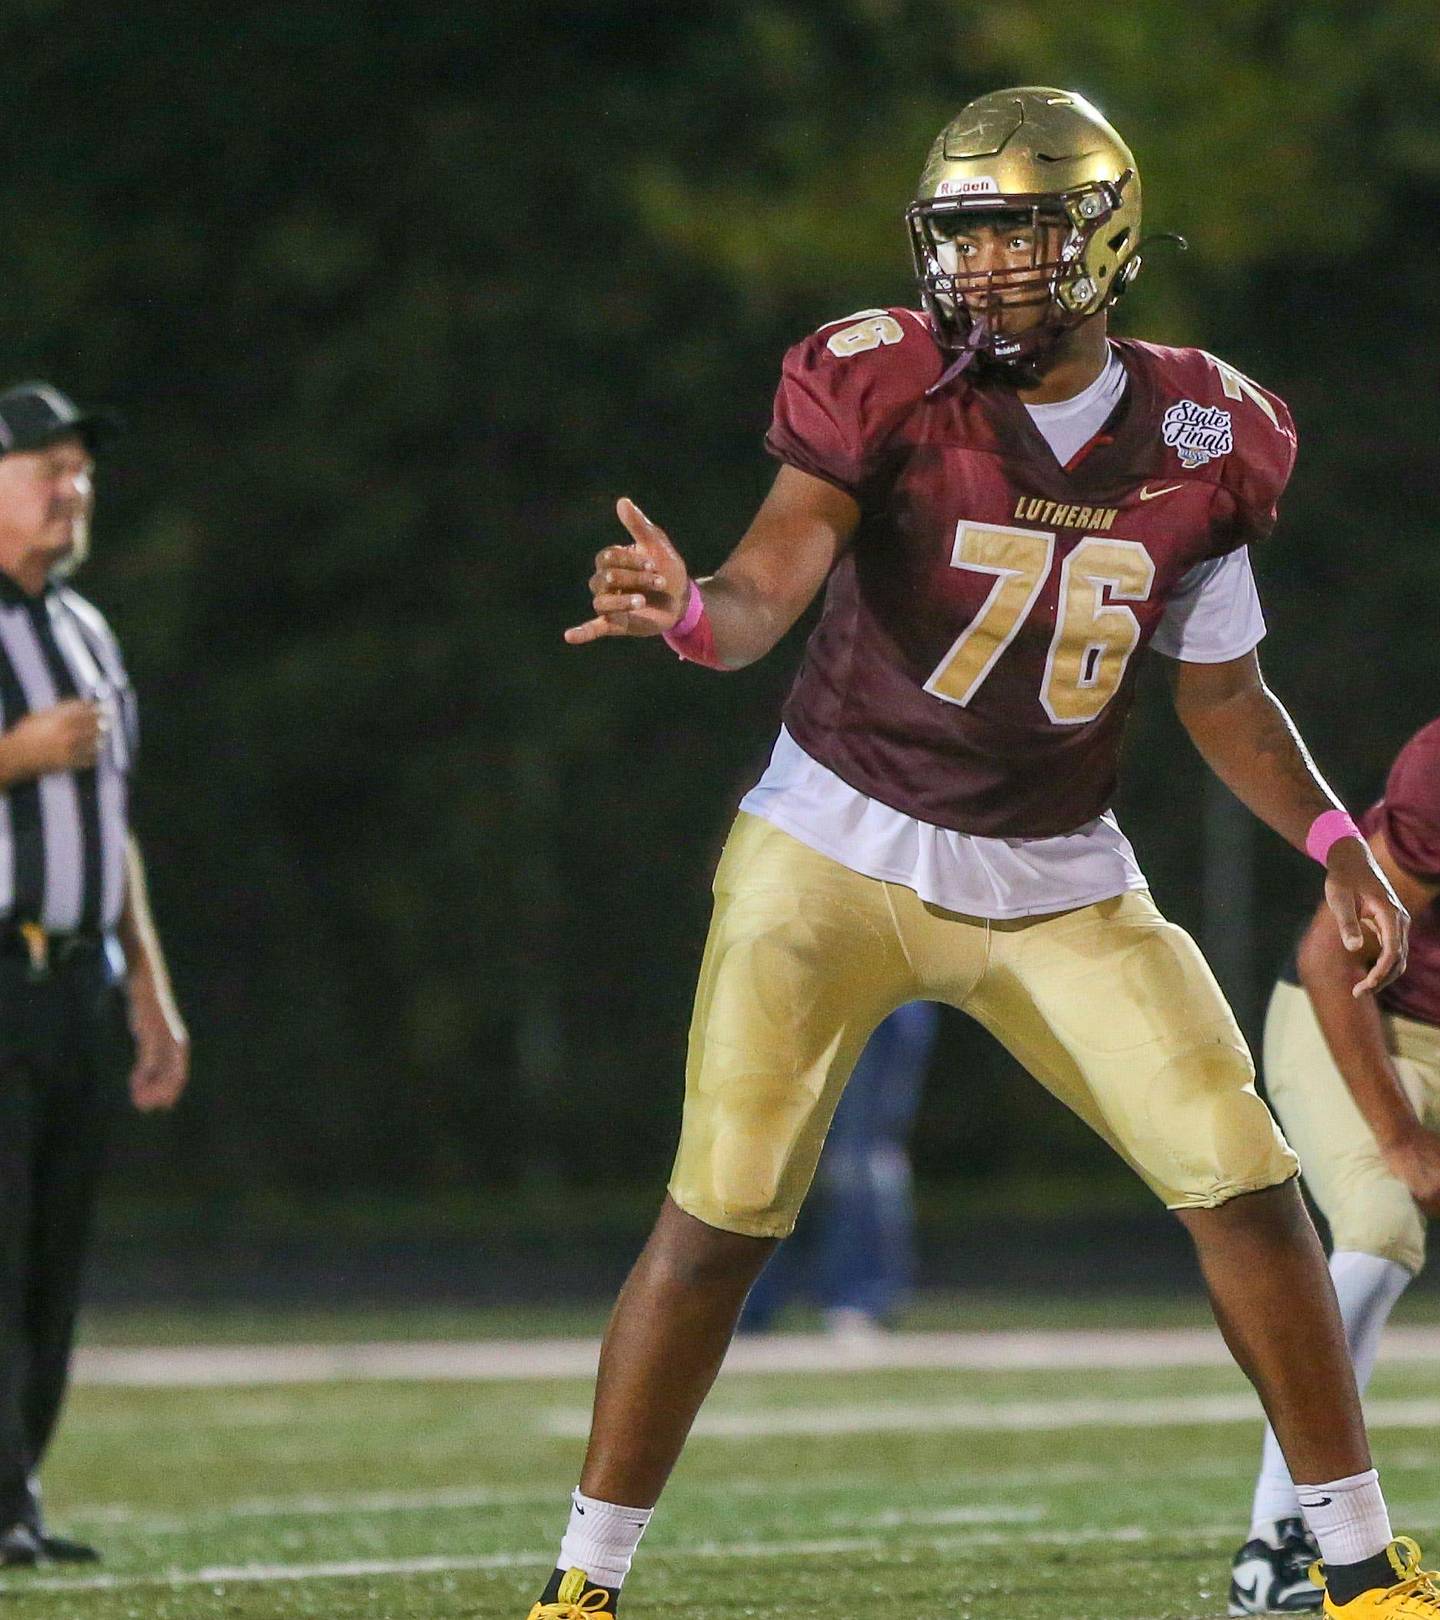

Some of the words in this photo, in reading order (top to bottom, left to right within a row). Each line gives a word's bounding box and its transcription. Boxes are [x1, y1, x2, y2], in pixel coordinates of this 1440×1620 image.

[941, 181, 989, 195] Rdell
[1167, 401, 1229, 428] State
[1164, 421, 1230, 455] Finals
[1014, 496, 1119, 530] LUTHERAN
[922, 519, 1156, 724] 76
